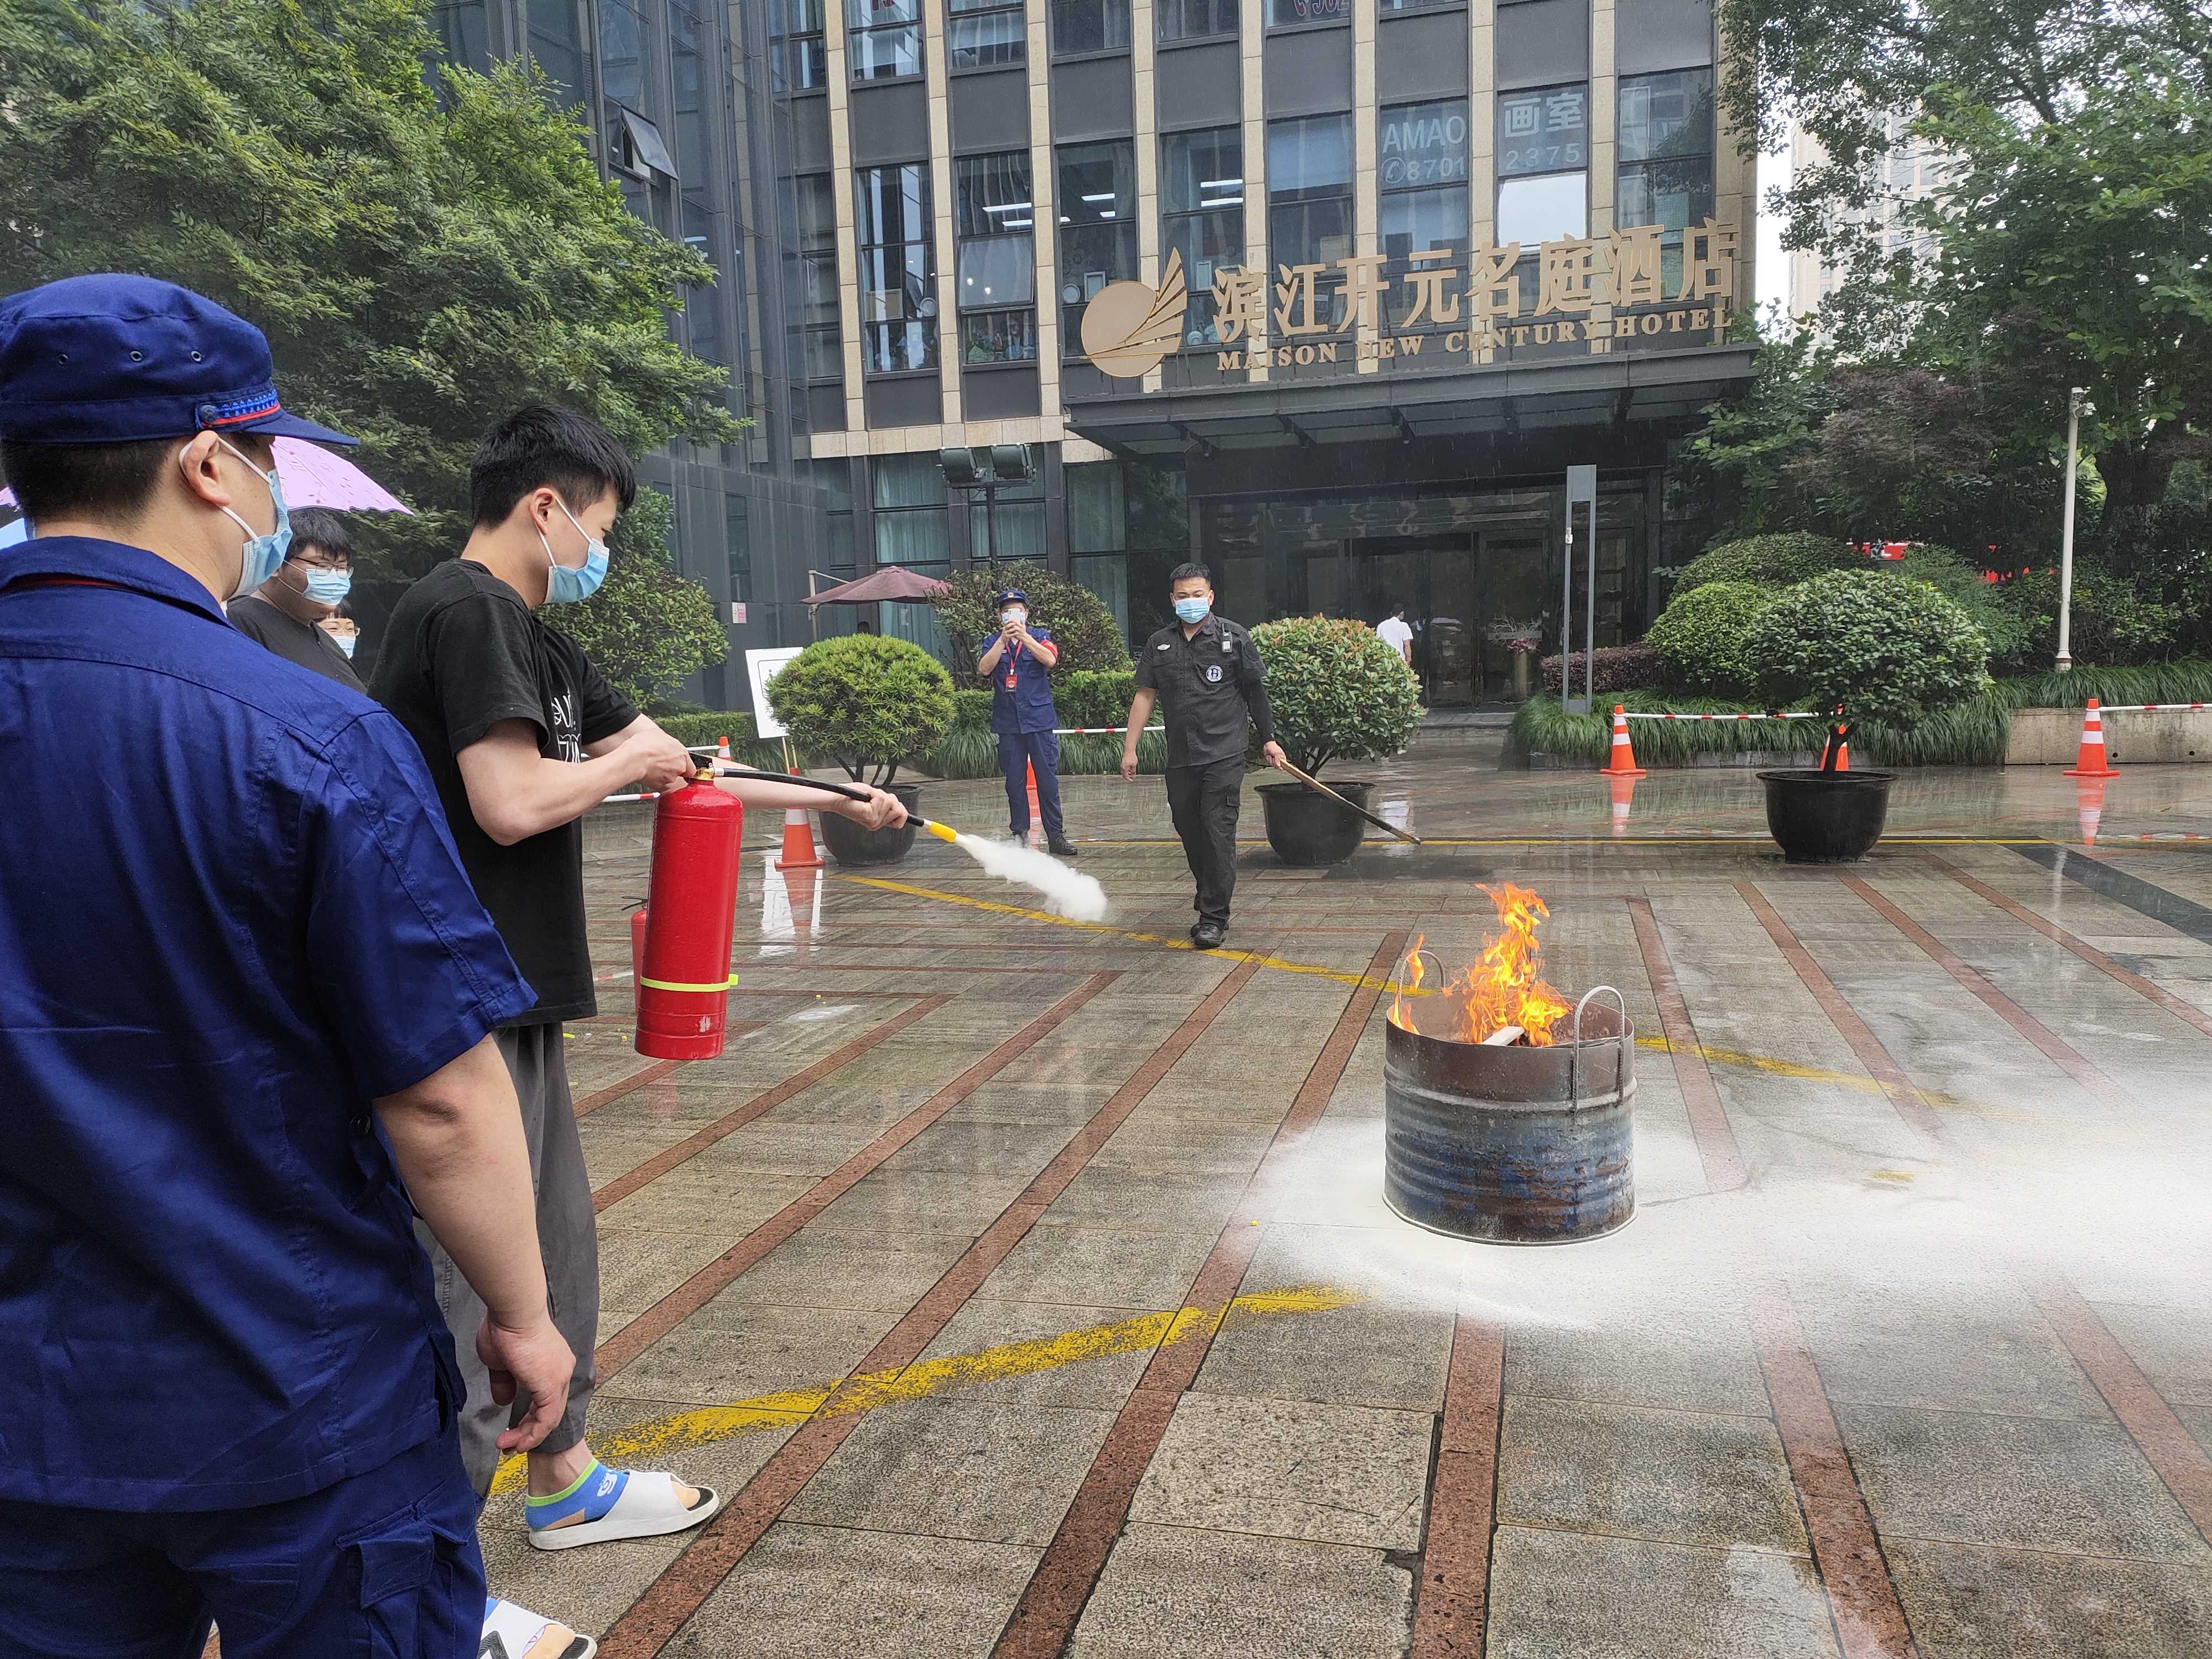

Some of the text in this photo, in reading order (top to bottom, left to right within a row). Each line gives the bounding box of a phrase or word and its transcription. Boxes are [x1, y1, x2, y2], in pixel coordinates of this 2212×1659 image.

[1383, 116, 1466, 153] AMAO
[1504, 92, 1584, 138] 画室
[1406, 143, 1580, 181] 8701 2375
[1212, 217, 1739, 342] 滨江开元名庭酒店
[1218, 306, 1733, 371] MAISON NEW CENTURY HOTEL
